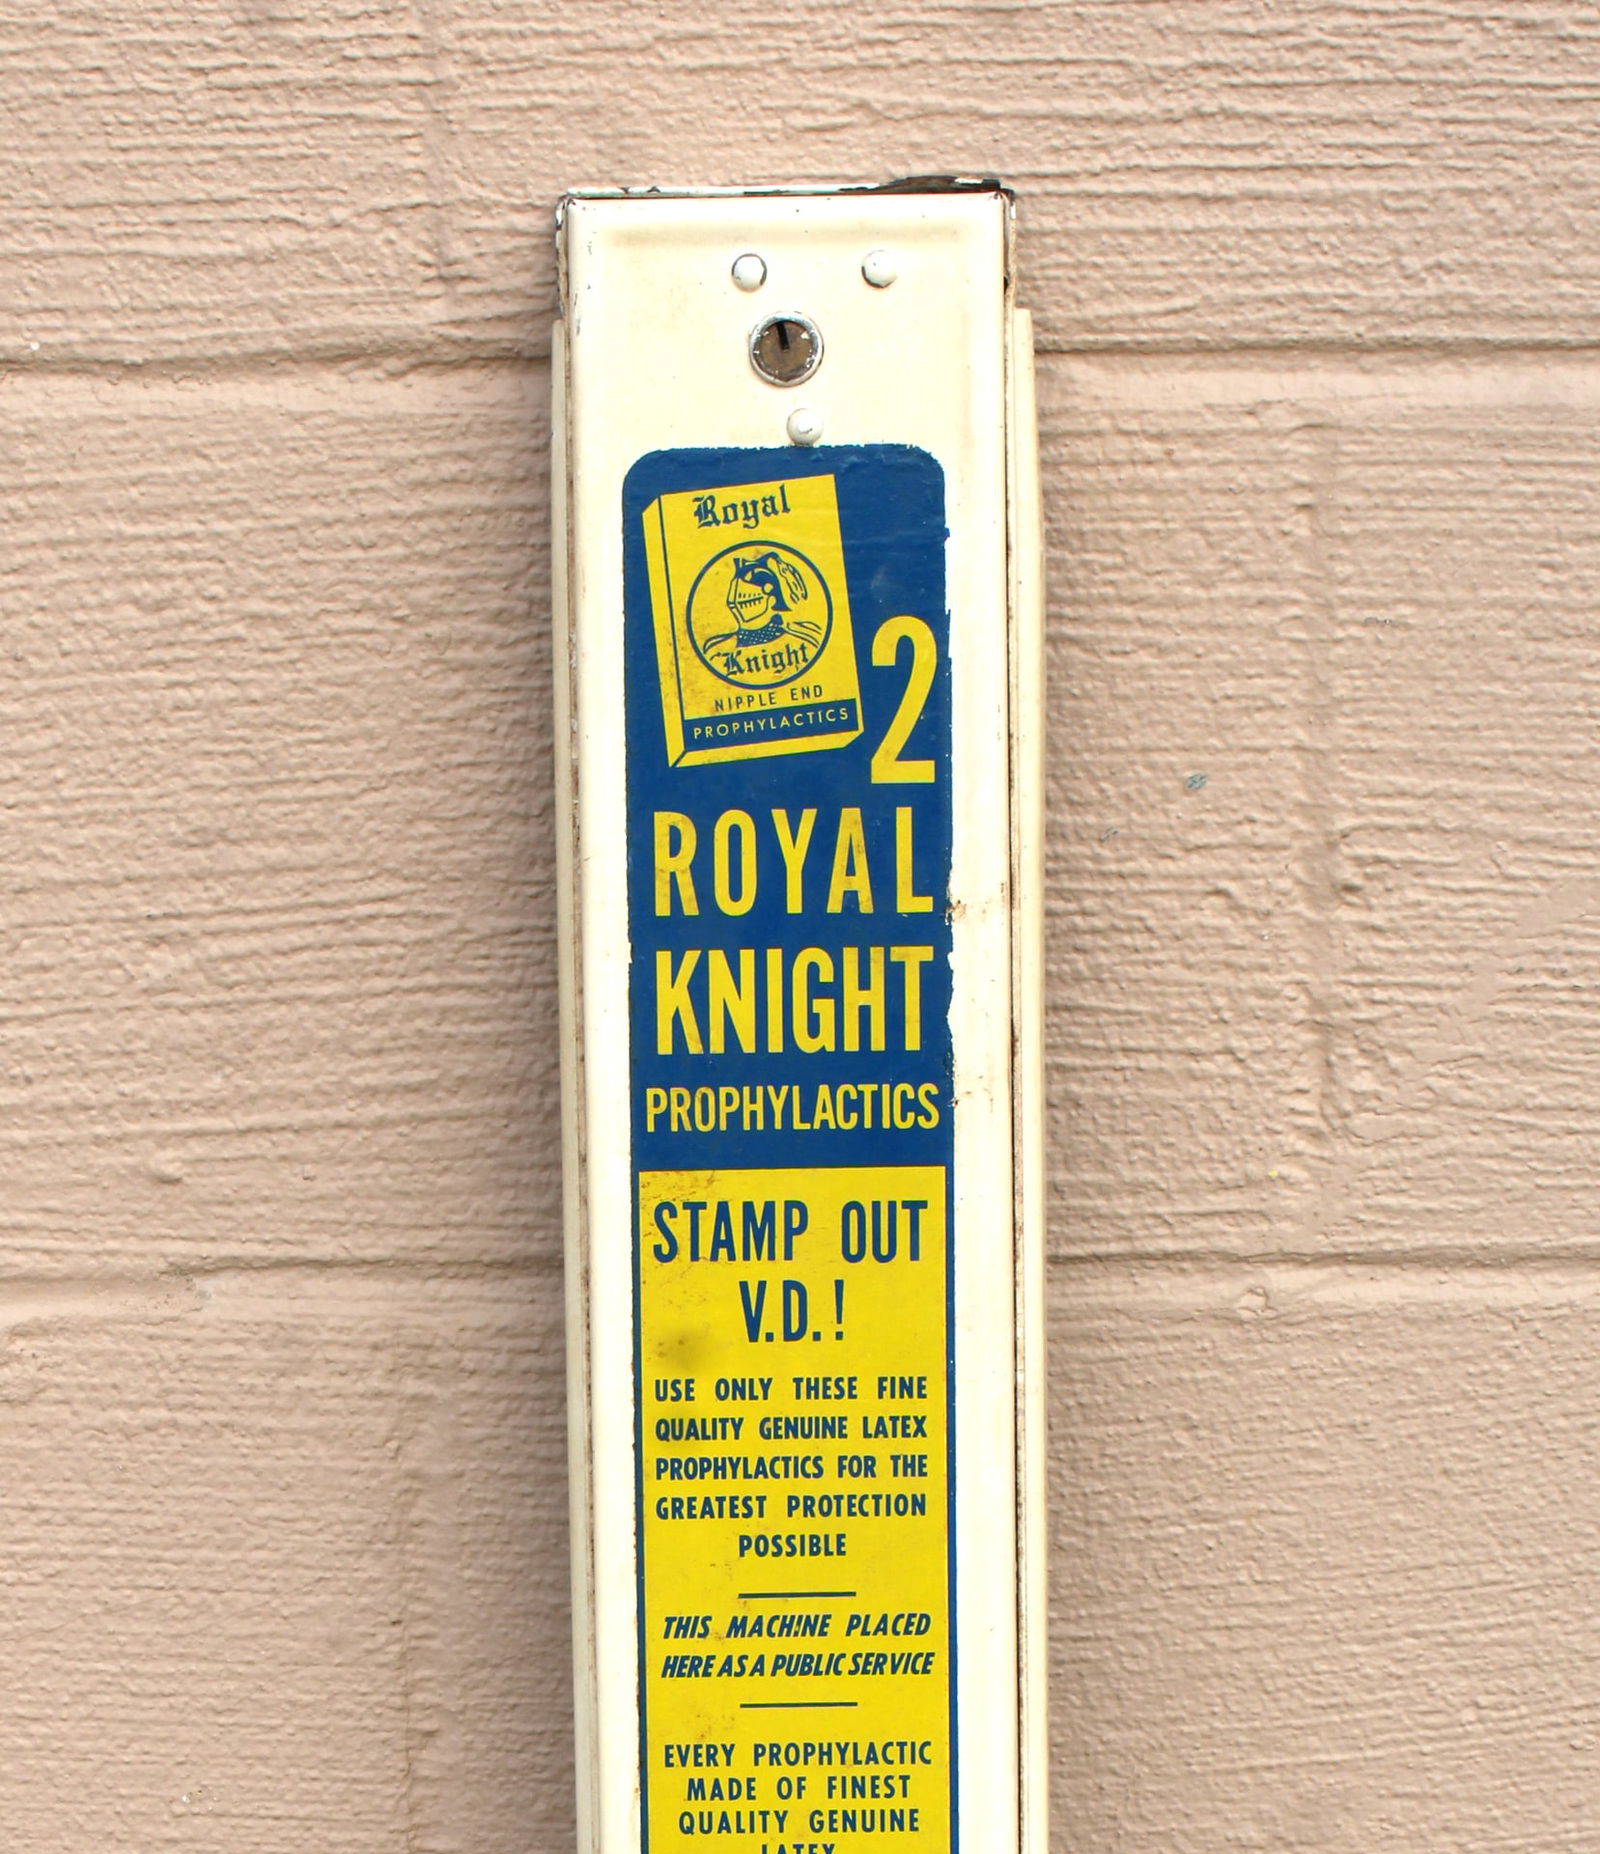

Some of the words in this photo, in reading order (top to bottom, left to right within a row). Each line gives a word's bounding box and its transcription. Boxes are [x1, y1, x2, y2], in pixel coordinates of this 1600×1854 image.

[692, 484, 791, 528] Royal
[710, 644, 810, 676] Knight
[715, 691, 776, 713] NIPPLE
[791, 685, 822, 701] END
[871, 616, 937, 783] 2
[694, 708, 848, 739] PROPHYLACTICS
[654, 807, 933, 916] ROYAL
[656, 946, 933, 1055] KNIGHT
[646, 1082, 939, 1132] PROPHYLACTICS
[653, 1200, 808, 1263] STAMP
[841, 1200, 928, 1263] OUT
[655, 1379, 695, 1402] USE
[715, 1378, 772, 1401] ONLY
[793, 1377, 858, 1400] THESE
[878, 1376, 927, 1399] FINE
[655, 1418, 744, 1441] QUALITY
[759, 1416, 848, 1439] GENUINE
[863, 1415, 927, 1438] LATEX
[656, 1455, 823, 1480] PROPHYLACTICS
[838, 1455, 876, 1478] FOR
[891, 1454, 928, 1478] THE
[656, 1496, 767, 1520] GREATEST
[787, 1494, 926, 1518] PROTECTION
[739, 1533, 846, 1558] POSSIBLE
[663, 1616, 712, 1639] THIS
[726, 1614, 831, 1638] MACHINE
[846, 1613, 931, 1637] PLACED
[661, 1655, 716, 1678] HERE
[717, 1654, 748, 1677] AS
[749, 1654, 765, 1677] A
[771, 1653, 846, 1676] PUBLIC
[848, 1652, 935, 1675] SERVICE
[664, 1743, 735, 1768] EVERY
[754, 1741, 932, 1766] PROPHYLACTIC
[687, 1777, 756, 1801] MADE
[776, 1776, 807, 1800] OF
[828, 1775, 910, 1799] FINEST
[679, 1810, 789, 1835] QUALITY
[809, 1809, 919, 1833] GENUINE
